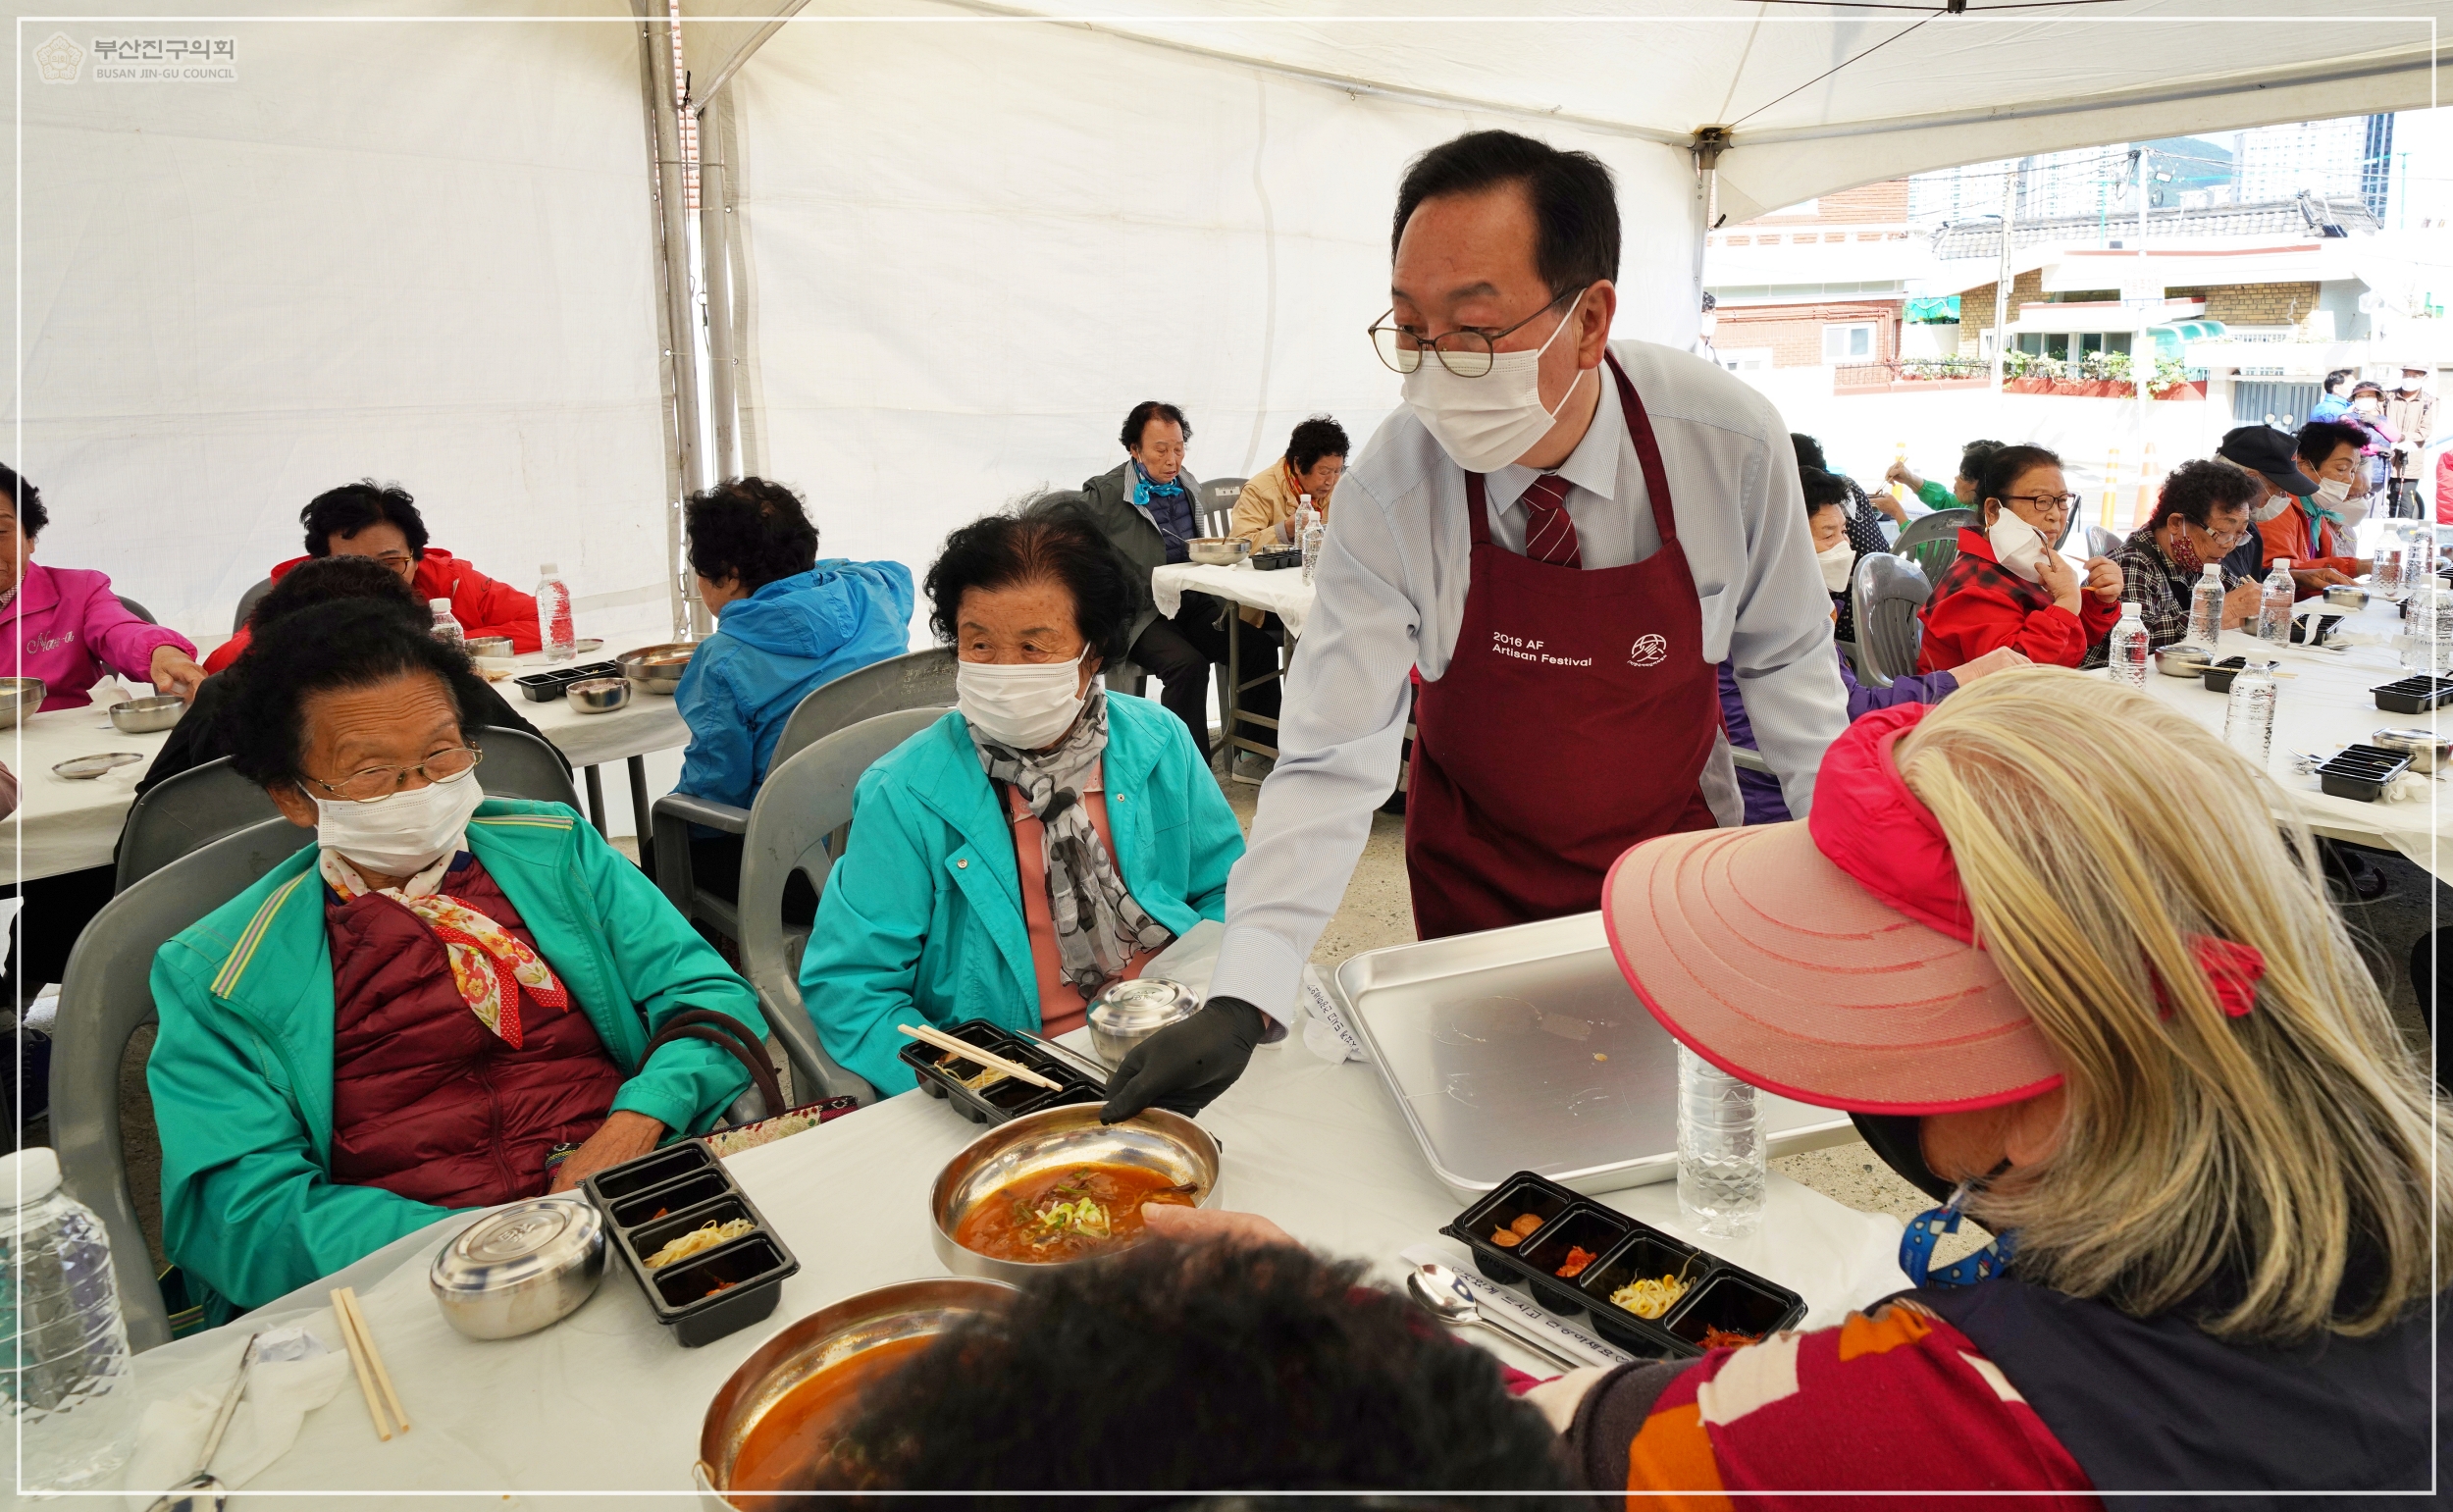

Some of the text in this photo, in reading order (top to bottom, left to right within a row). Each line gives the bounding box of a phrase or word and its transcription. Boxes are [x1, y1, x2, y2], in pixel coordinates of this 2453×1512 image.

[1493, 631, 1544, 651] 2016 AF
[1492, 644, 1592, 667] Artisan Festival
